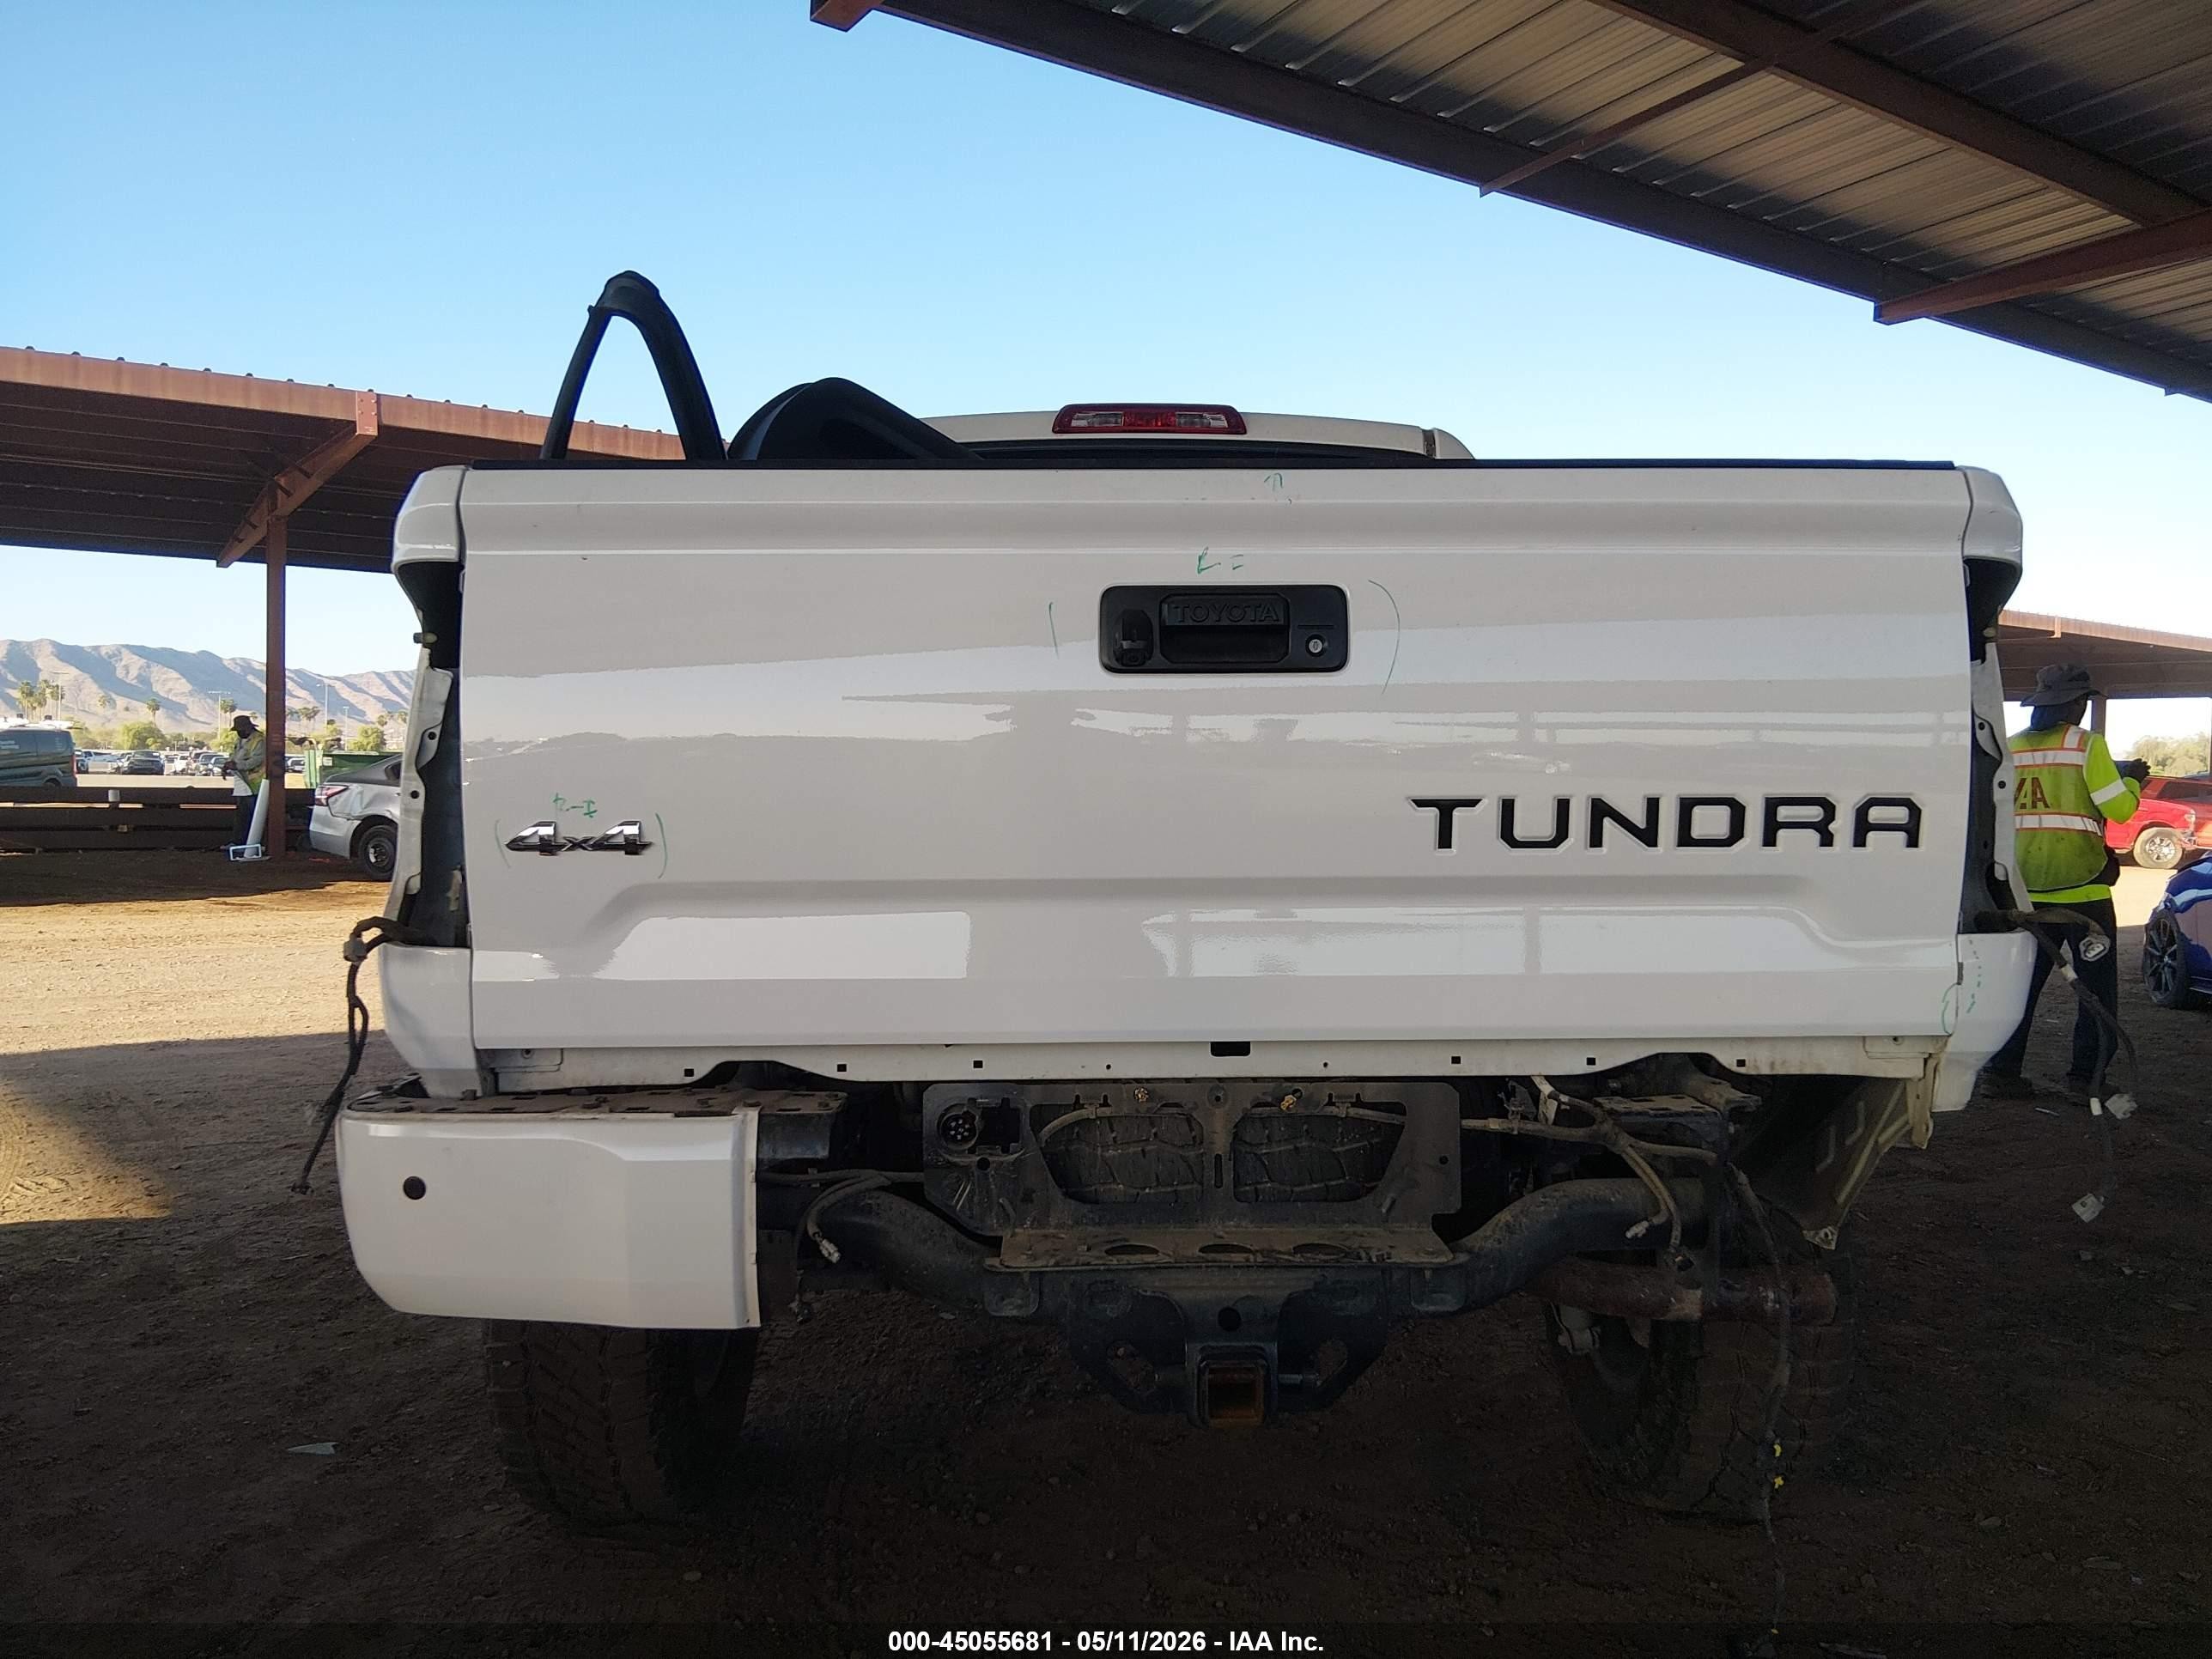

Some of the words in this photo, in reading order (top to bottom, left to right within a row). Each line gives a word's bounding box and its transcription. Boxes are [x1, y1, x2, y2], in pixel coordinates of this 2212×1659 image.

[1172, 603, 1280, 623] TOYOTA
[504, 820, 653, 856] 4x4
[1408, 796, 1923, 850] TUNDRA
